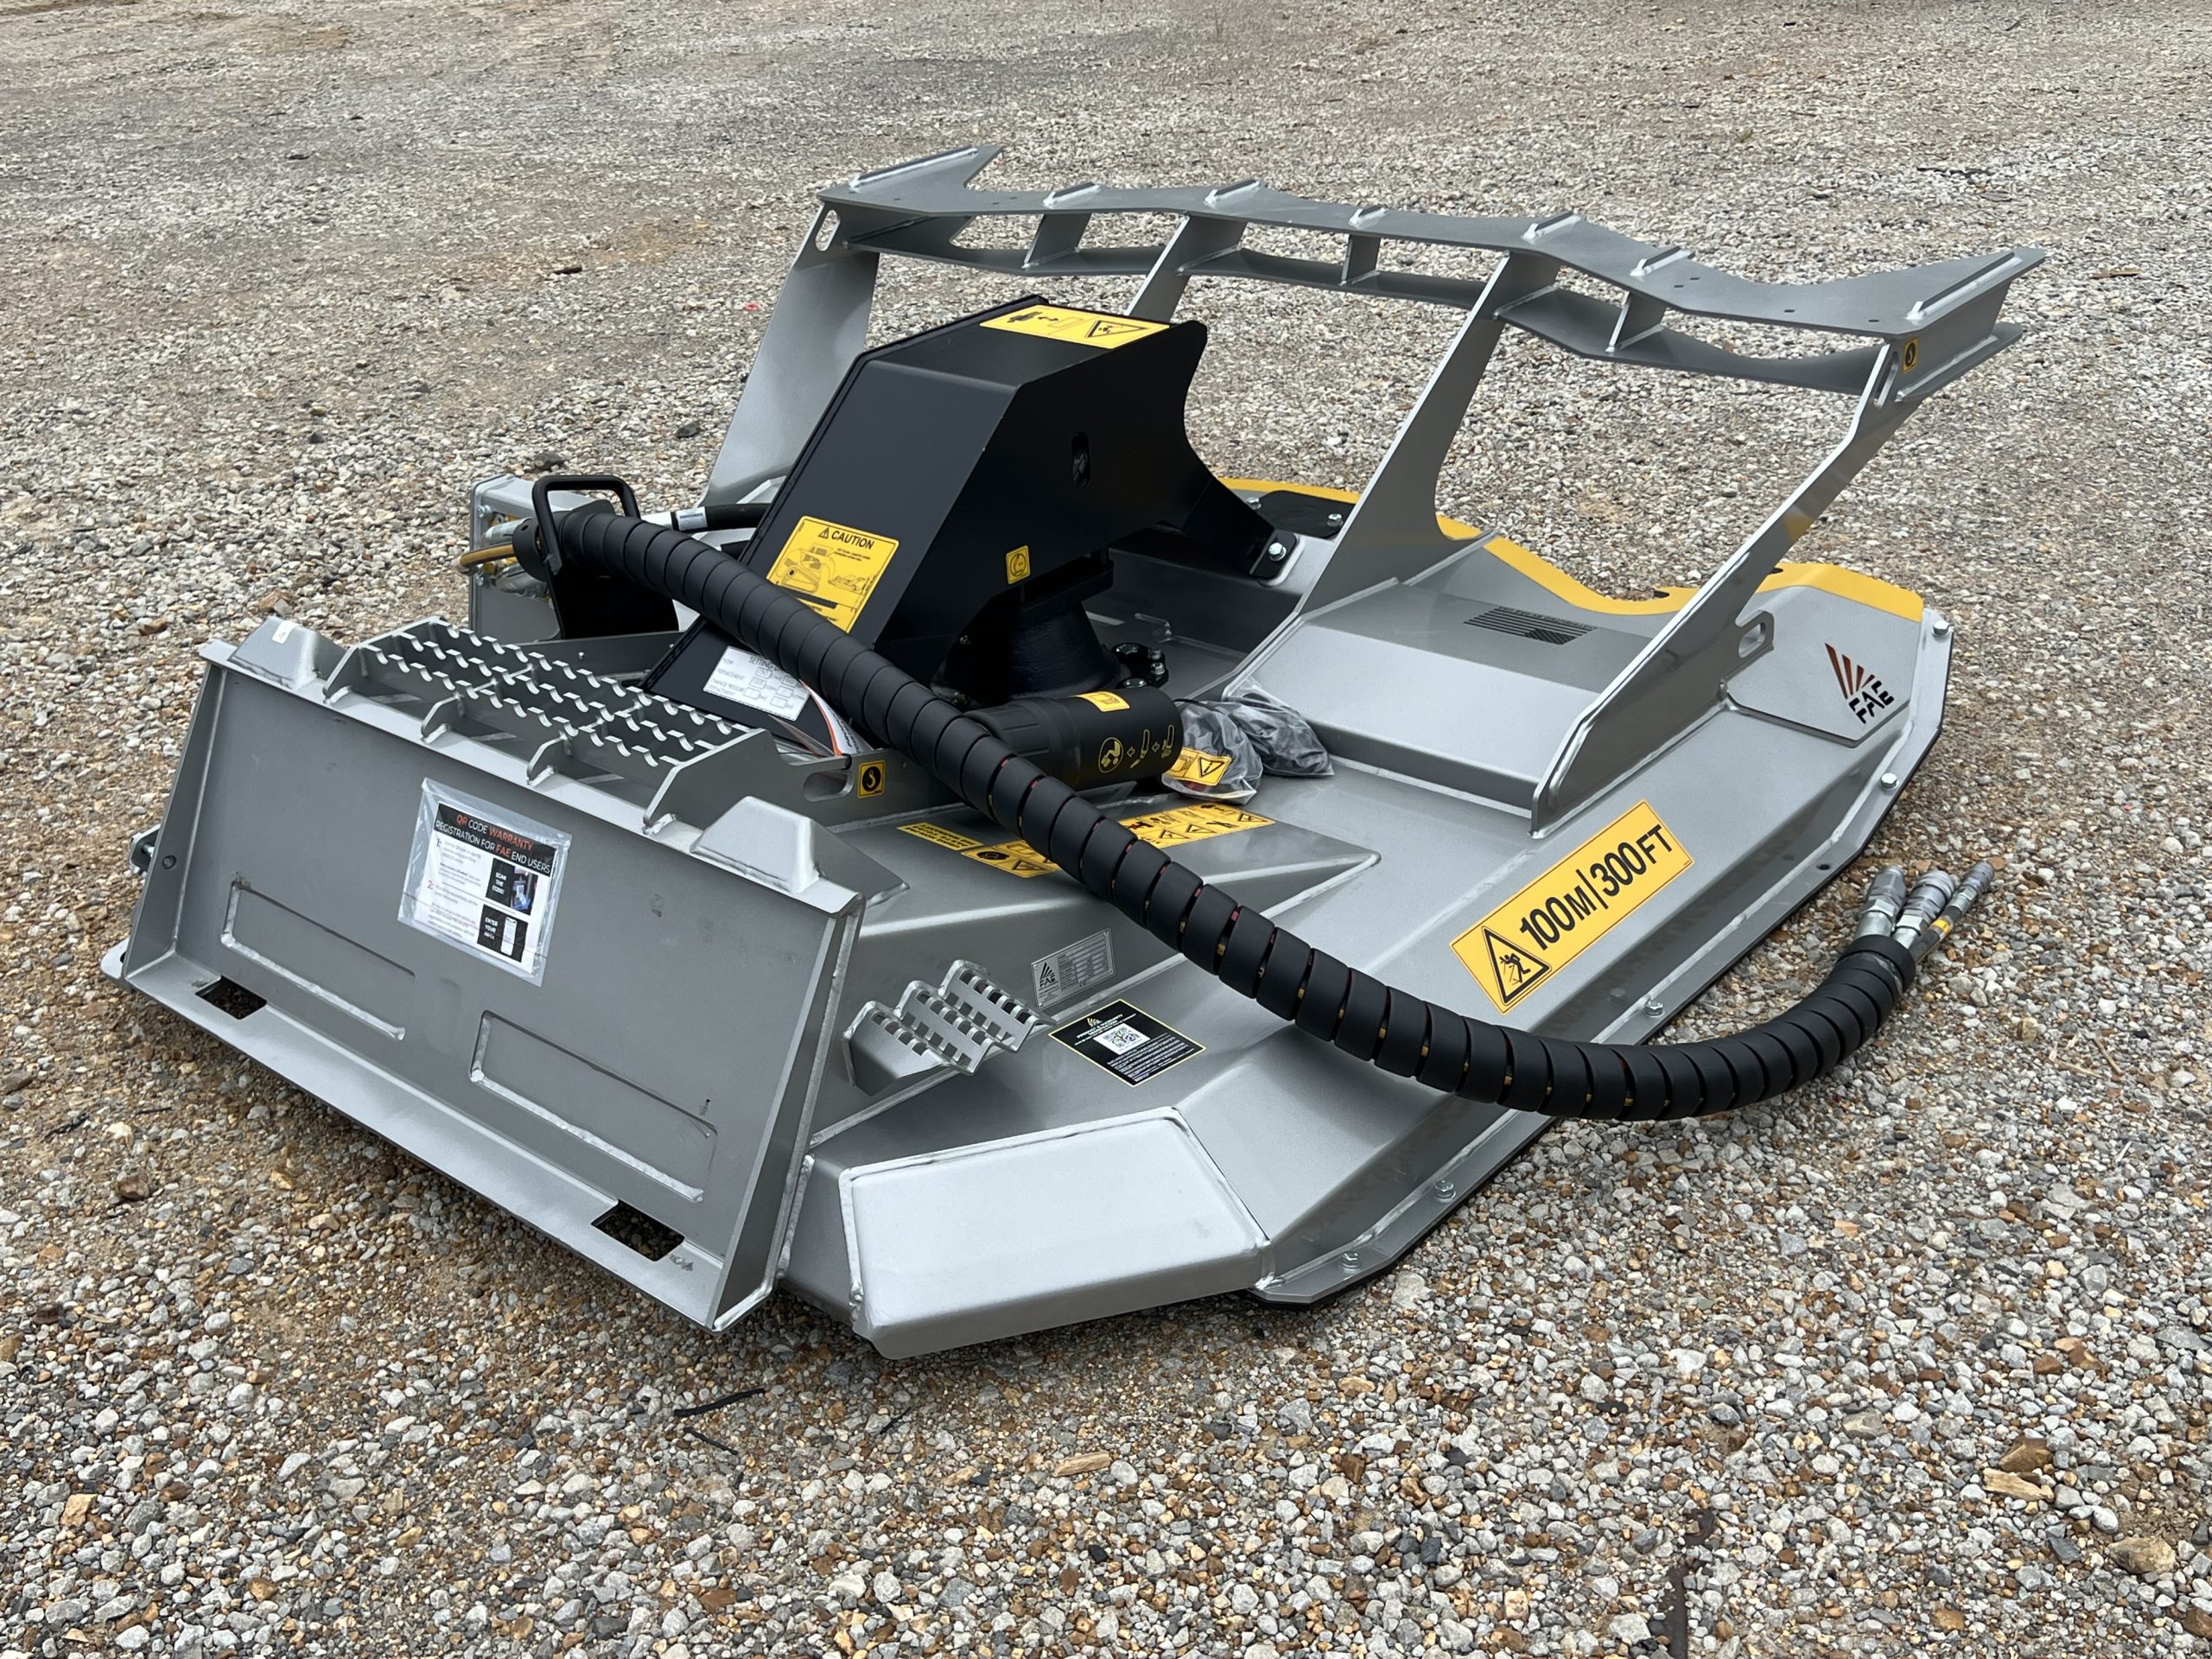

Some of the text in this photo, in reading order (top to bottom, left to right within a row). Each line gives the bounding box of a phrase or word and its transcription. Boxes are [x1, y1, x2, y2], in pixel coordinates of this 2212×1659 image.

[831, 531, 875, 550] CAUTION
[1848, 680, 1895, 725] FAE
[435, 820, 480, 848] REGISTRATION
[480, 838, 495, 852] FOR
[495, 844, 512, 858] FAE
[511, 850, 528, 864] END
[527, 858, 551, 874] USERS
[456, 814, 468, 827] QR
[467, 819, 488, 835] CODE
[489, 826, 534, 852] WARRANTY
[1039, 973, 1057, 988] FAE
